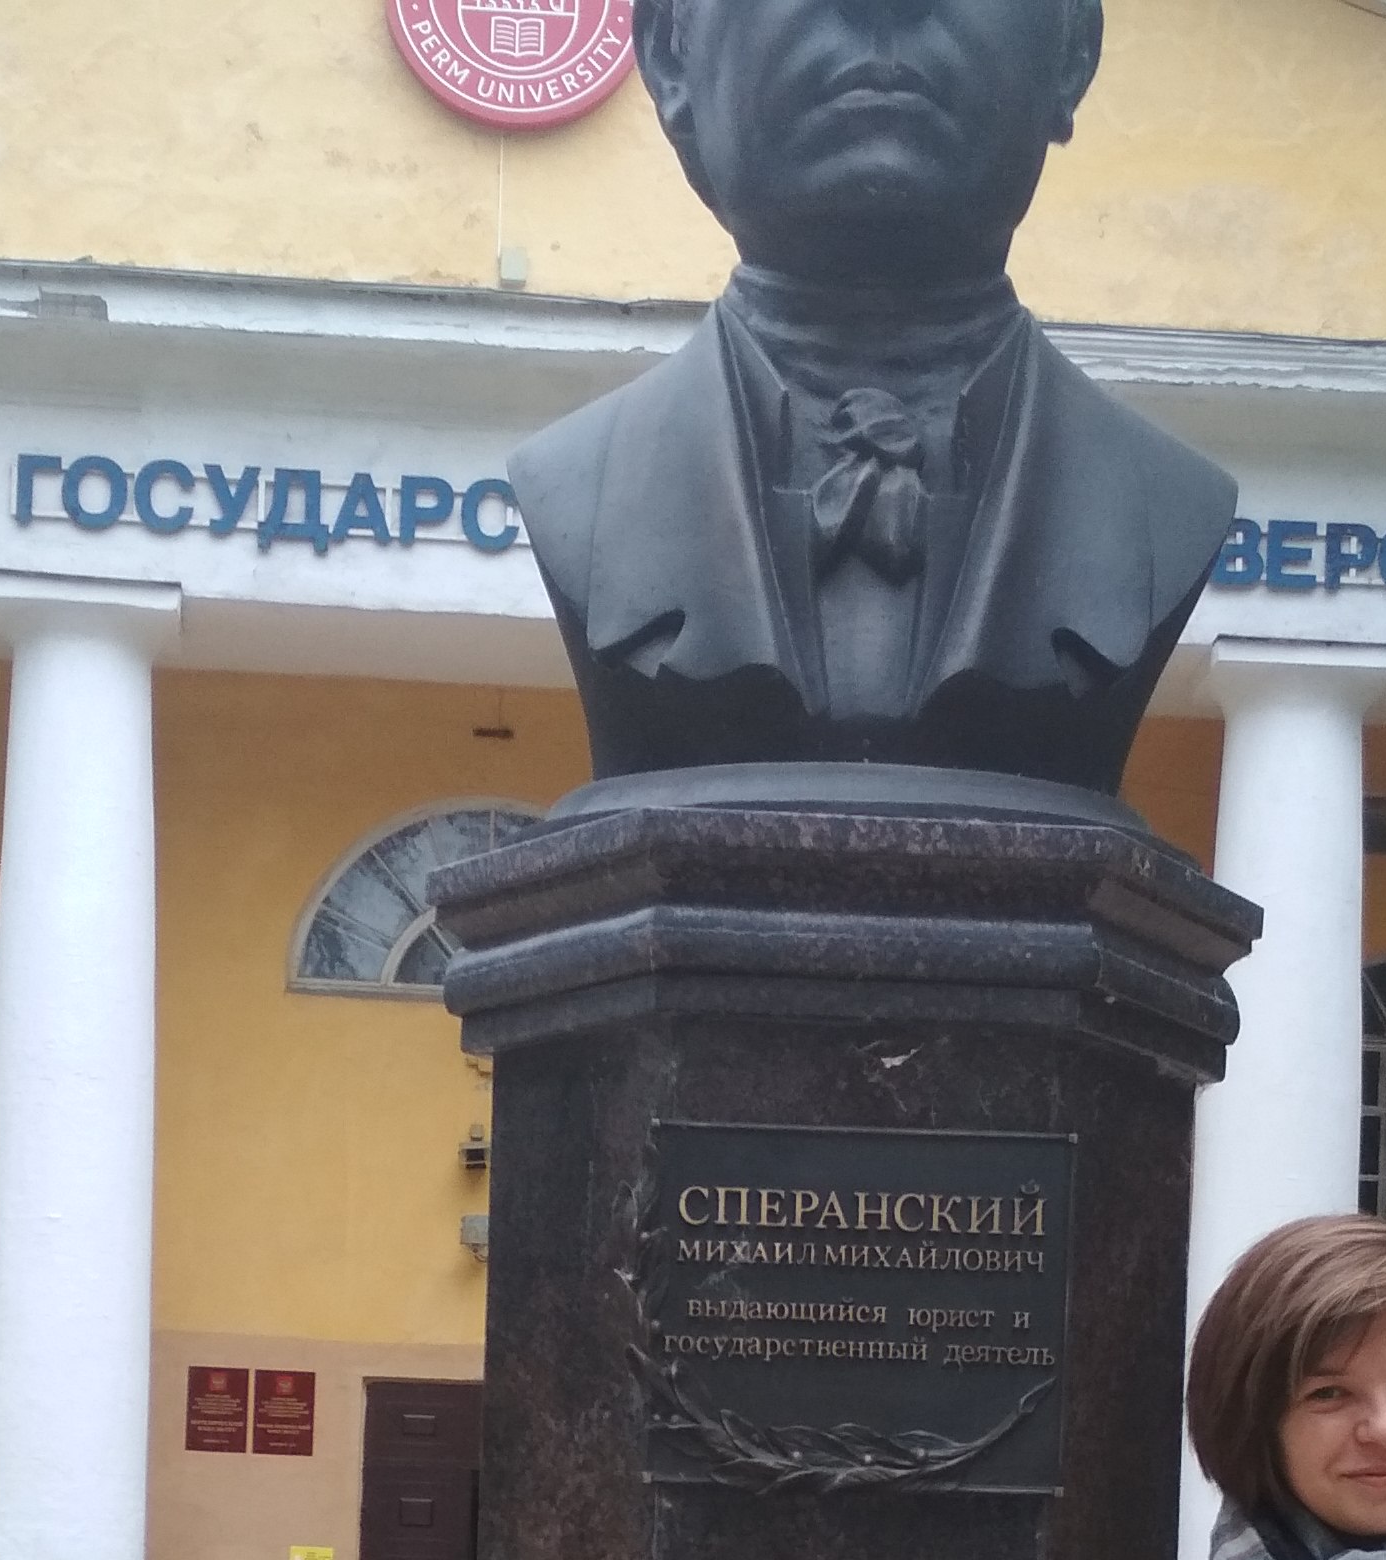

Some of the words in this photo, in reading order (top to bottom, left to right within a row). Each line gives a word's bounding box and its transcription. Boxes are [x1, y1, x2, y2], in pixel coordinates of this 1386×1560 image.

[411, 18, 470, 86] PERM
[476, 28, 623, 105] UNIVERSITY
[678, 1179, 1047, 1237] СПЕРАНСКИЙ
[676, 1238, 816, 1265] МИХАИЛ
[823, 1240, 1045, 1273] МИХАЙЛОВИЧ
[686, 1296, 887, 1324] выдающийся
[908, 1306, 995, 1334] юрист
[1014, 1310, 1031, 1329] и
[663, 1332, 929, 1363] государственный
[943, 1342, 1056, 1372] деятель
